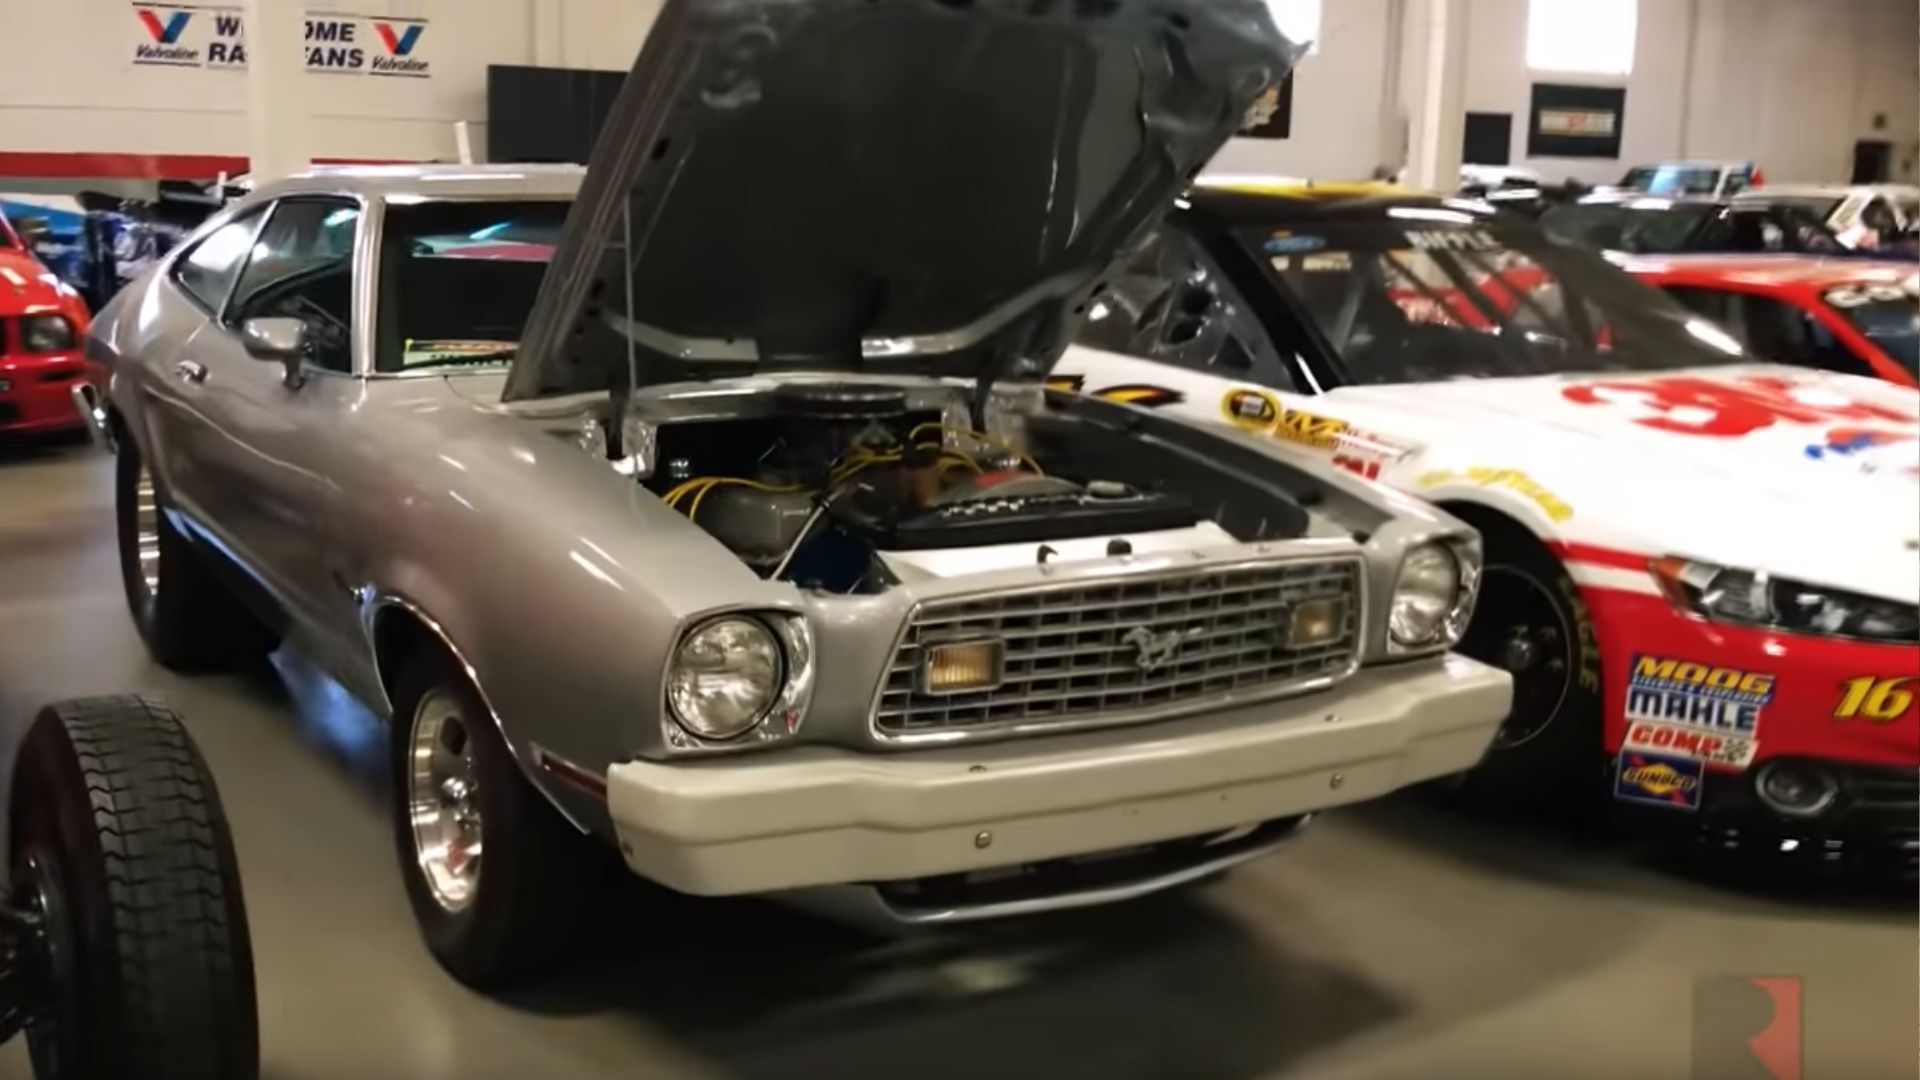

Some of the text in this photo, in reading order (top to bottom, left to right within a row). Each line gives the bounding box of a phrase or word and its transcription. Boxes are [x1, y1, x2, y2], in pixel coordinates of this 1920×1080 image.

[136, 44, 199, 59] Valvoline
[305, 46, 364, 69] ANS
[371, 56, 429, 71] Valvoline
[1634, 655, 1775, 695] MOOG
[1629, 687, 1755, 730] MAHLE
[1833, 675, 1918, 720] 16
[1631, 724, 1723, 752] COMP
[1622, 766, 1697, 793] SUNOCO
